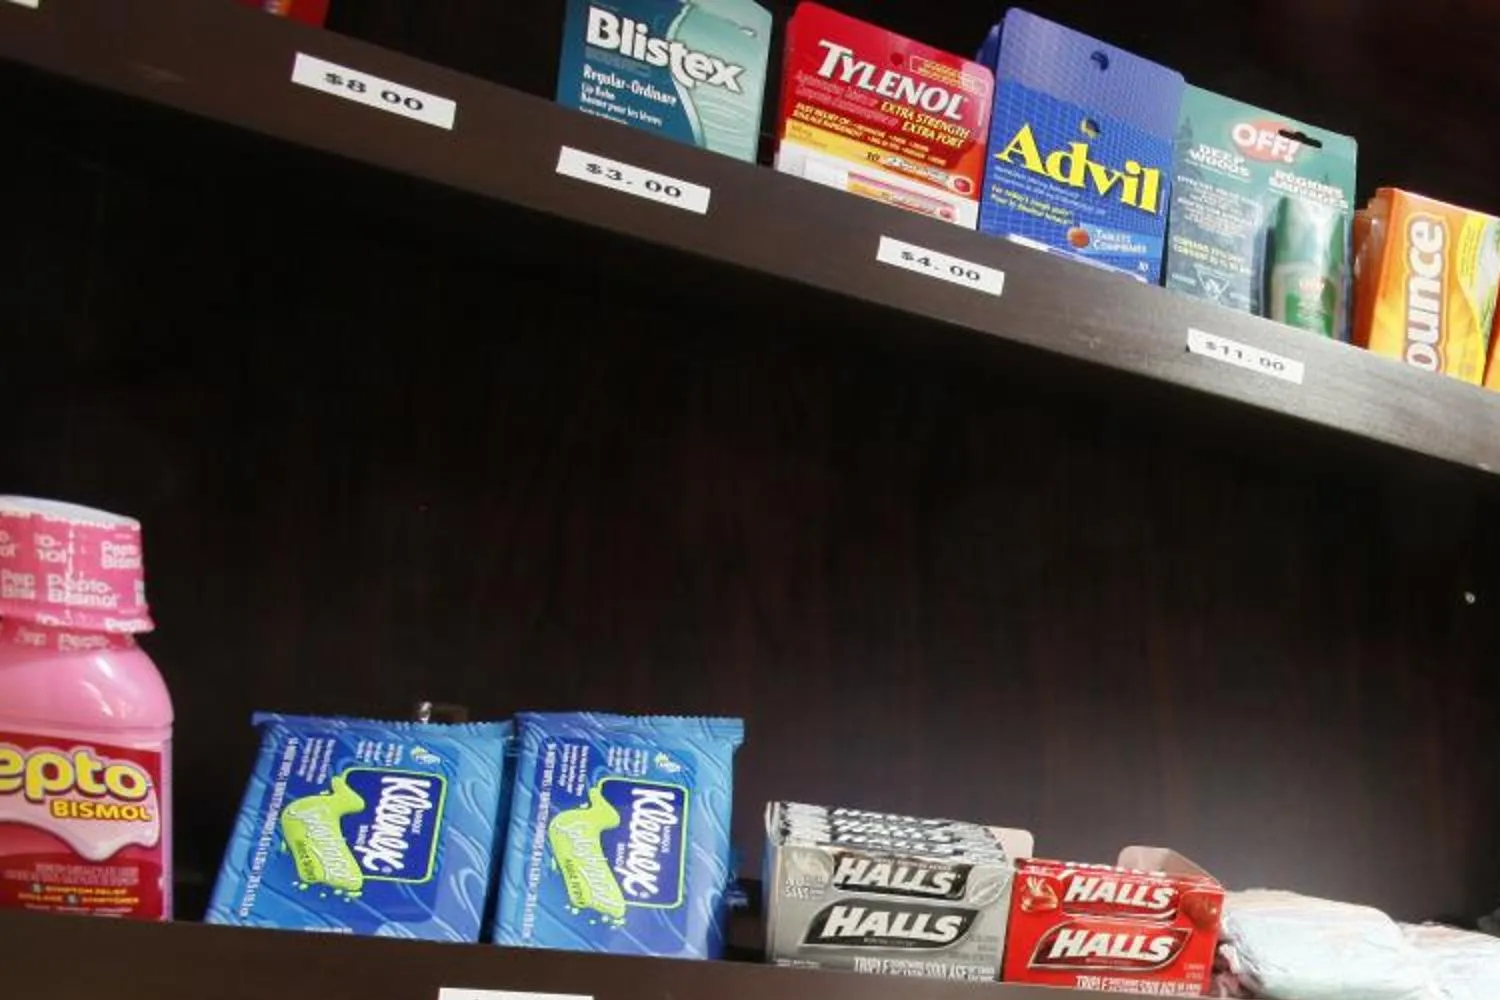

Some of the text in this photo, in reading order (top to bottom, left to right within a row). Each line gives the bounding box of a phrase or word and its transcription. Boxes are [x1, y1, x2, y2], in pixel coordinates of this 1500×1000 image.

[585, 5, 746, 94] Blistex
[324, 72, 424, 111] $800
[817, 39, 965, 121] TYLENOL
[1232, 123, 1302, 163] OFF!
[586, 162, 682, 198] $3.00
[993, 122, 1163, 214] Advil
[901, 251, 981, 281] $4.00
[1404, 219, 1444, 373] ounce
[0, 746, 149, 804] epto
[51, 798, 154, 822] BISMOL
[361, 775, 433, 873] Kleenex
[623, 787, 679, 898] Kleenex
[833, 855, 959, 894] HALLS
[1064, 876, 1177, 909] HALLS
[821, 905, 965, 942] HALLS
[1048, 928, 1175, 962] HALLS
